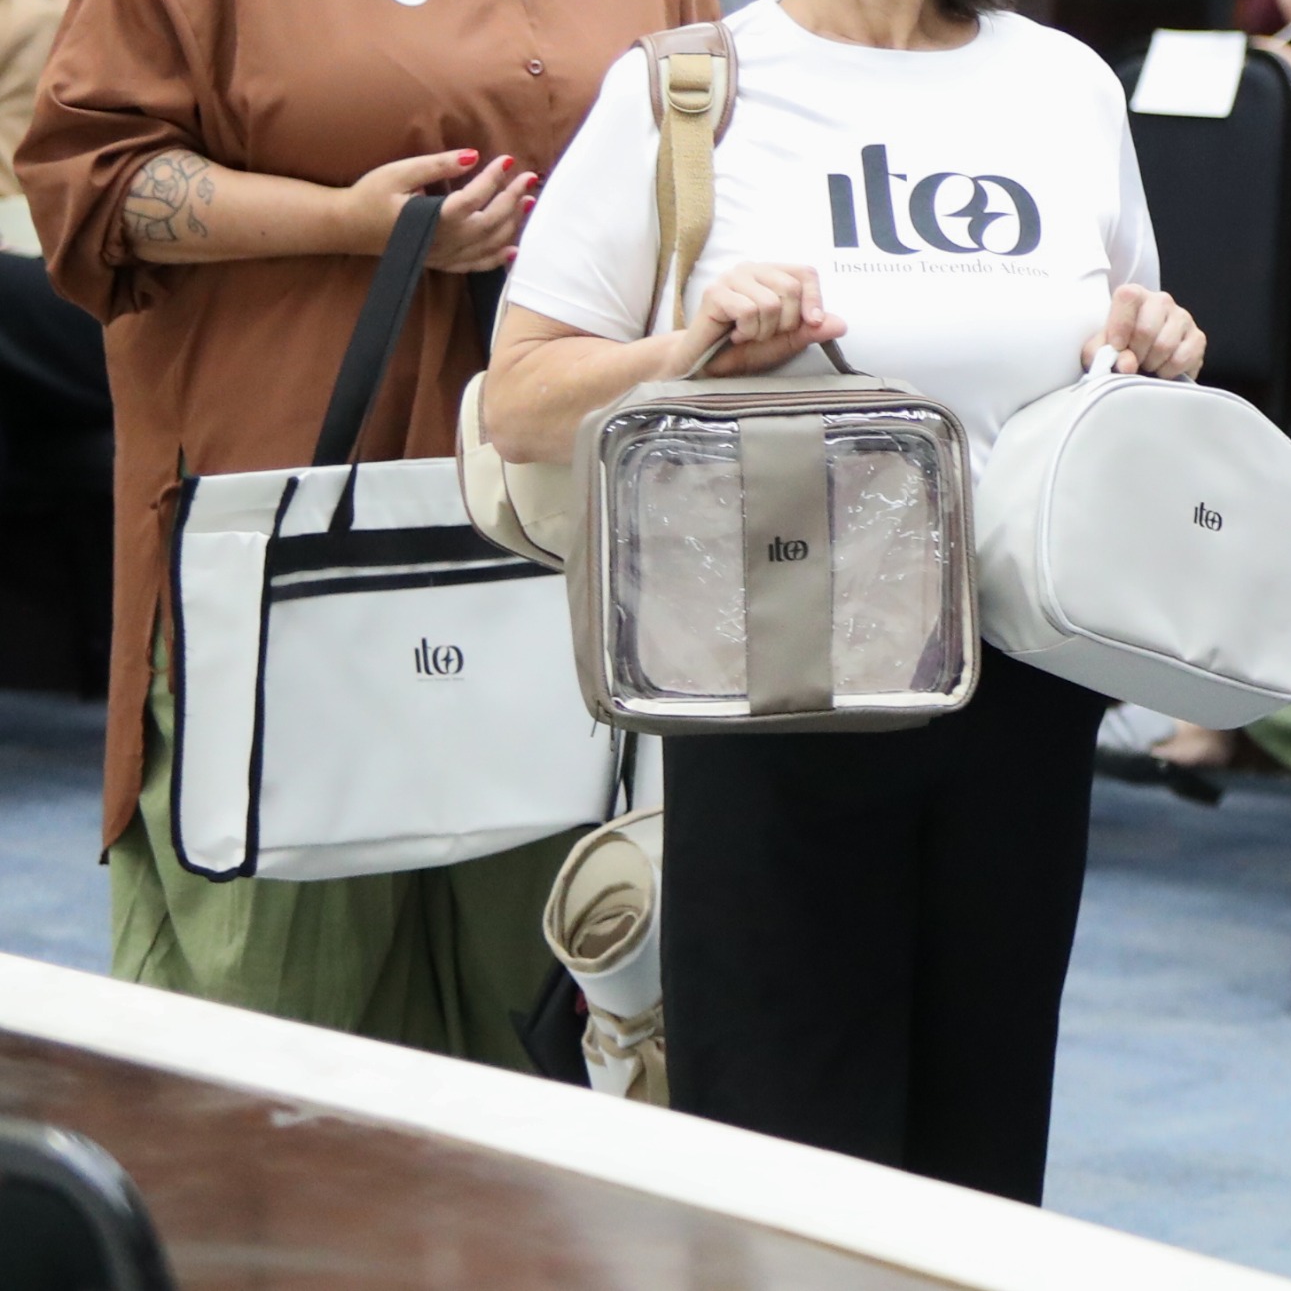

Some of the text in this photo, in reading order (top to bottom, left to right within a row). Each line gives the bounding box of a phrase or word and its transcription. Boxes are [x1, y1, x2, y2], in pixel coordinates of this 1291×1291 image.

[833, 259, 1050, 279] Instituto Tecendo Afetos
